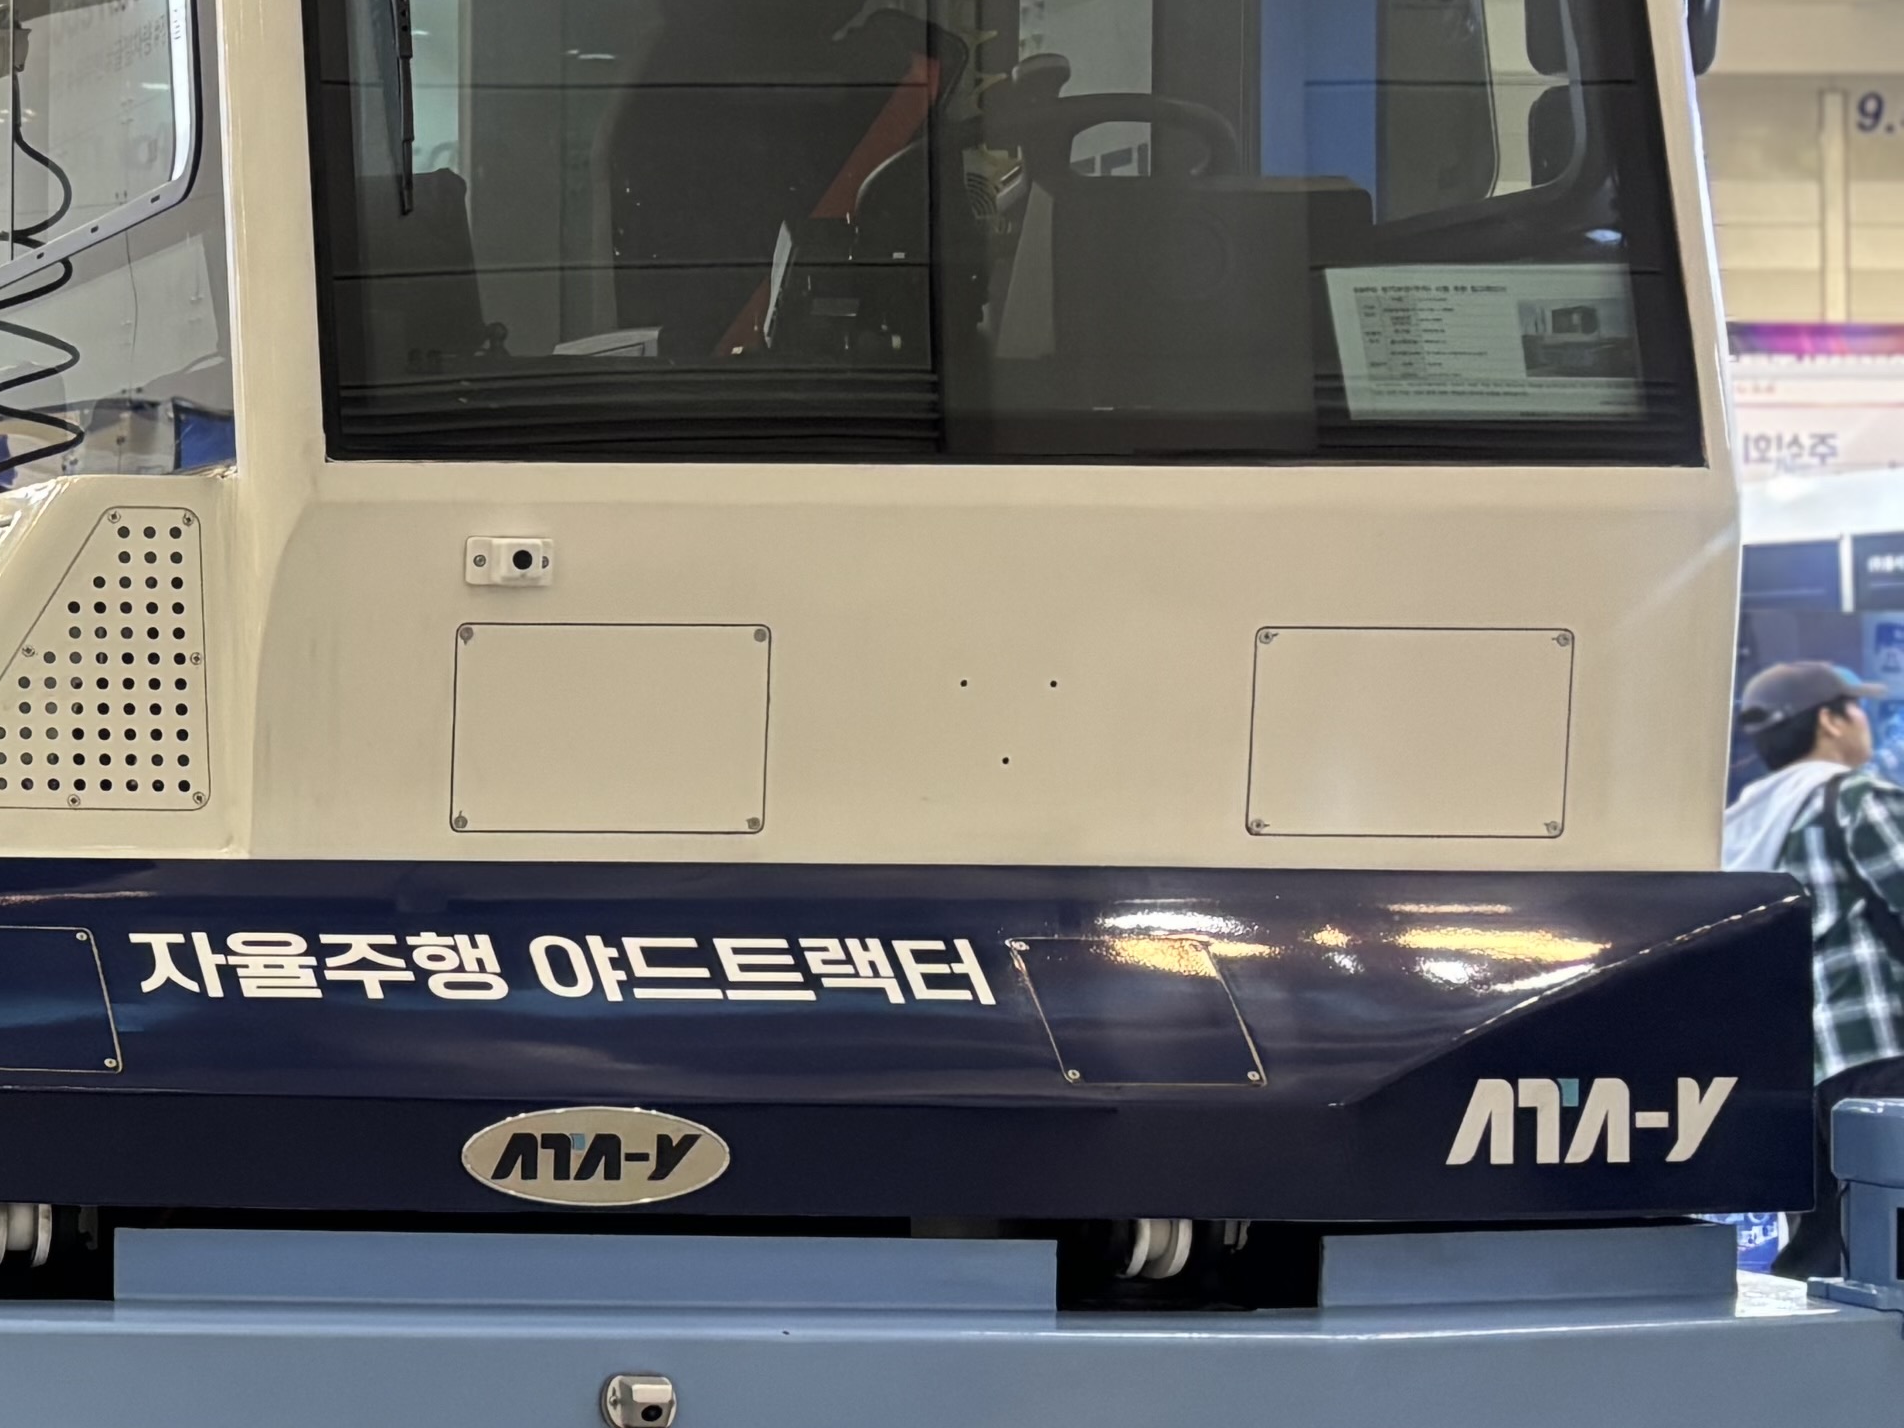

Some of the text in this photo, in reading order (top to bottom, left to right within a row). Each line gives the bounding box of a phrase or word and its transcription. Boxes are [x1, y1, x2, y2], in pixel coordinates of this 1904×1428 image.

[1856, 90, 1904, 133] 9.
[129, 929, 998, 1008] 자율주행 야드트랙터
[1445, 1076, 1738, 1165] ATA-Y
[490, 1131, 704, 1184] ATA-Y
